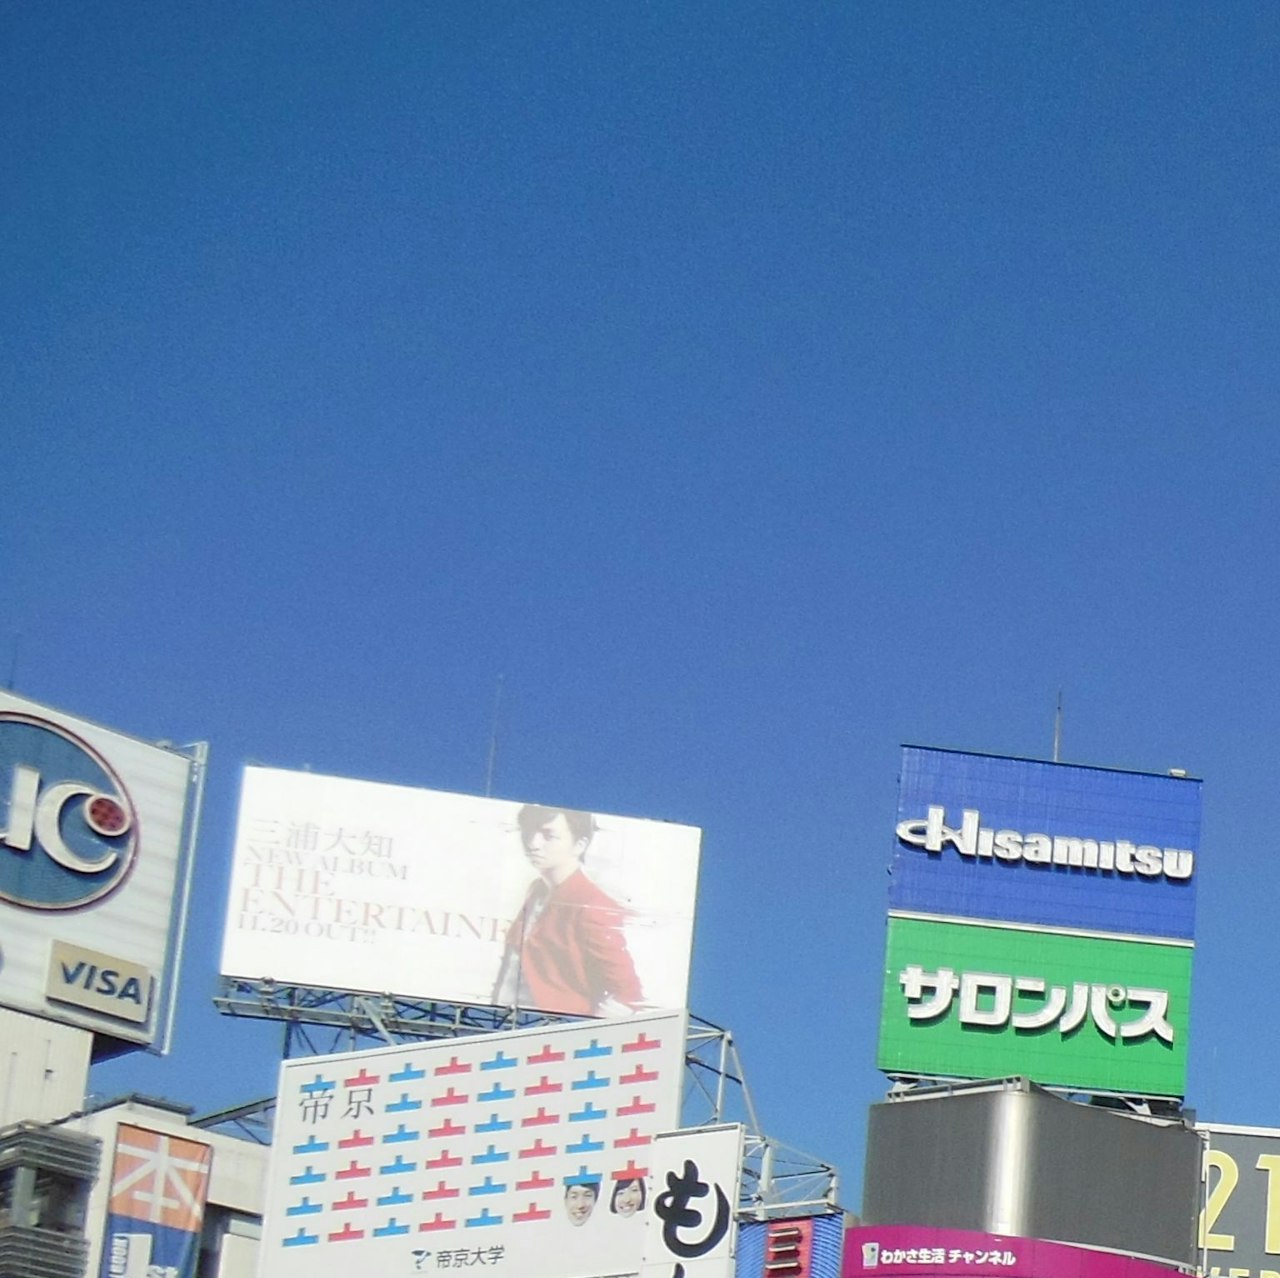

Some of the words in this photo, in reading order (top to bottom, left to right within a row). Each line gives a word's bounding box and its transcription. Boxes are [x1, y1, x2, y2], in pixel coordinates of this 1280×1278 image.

[248, 817, 394, 858] 三浦大知
[895, 805, 1194, 880] Hisamitsu
[244, 862, 335, 896] THE
[245, 845, 305, 865] NEW
[318, 856, 409, 880] ALBUM
[58, 960, 143, 1006] VISA
[899, 964, 1174, 1043] サロンパス
[299, 1085, 375, 1123] 帝京
[111, 1135, 208, 1222] 本
[435, 1246, 505, 1269] 帝京大学
[880, 1248, 945, 1266] わかさ生活
[948, 1249, 1016, 1267] チャンネル
